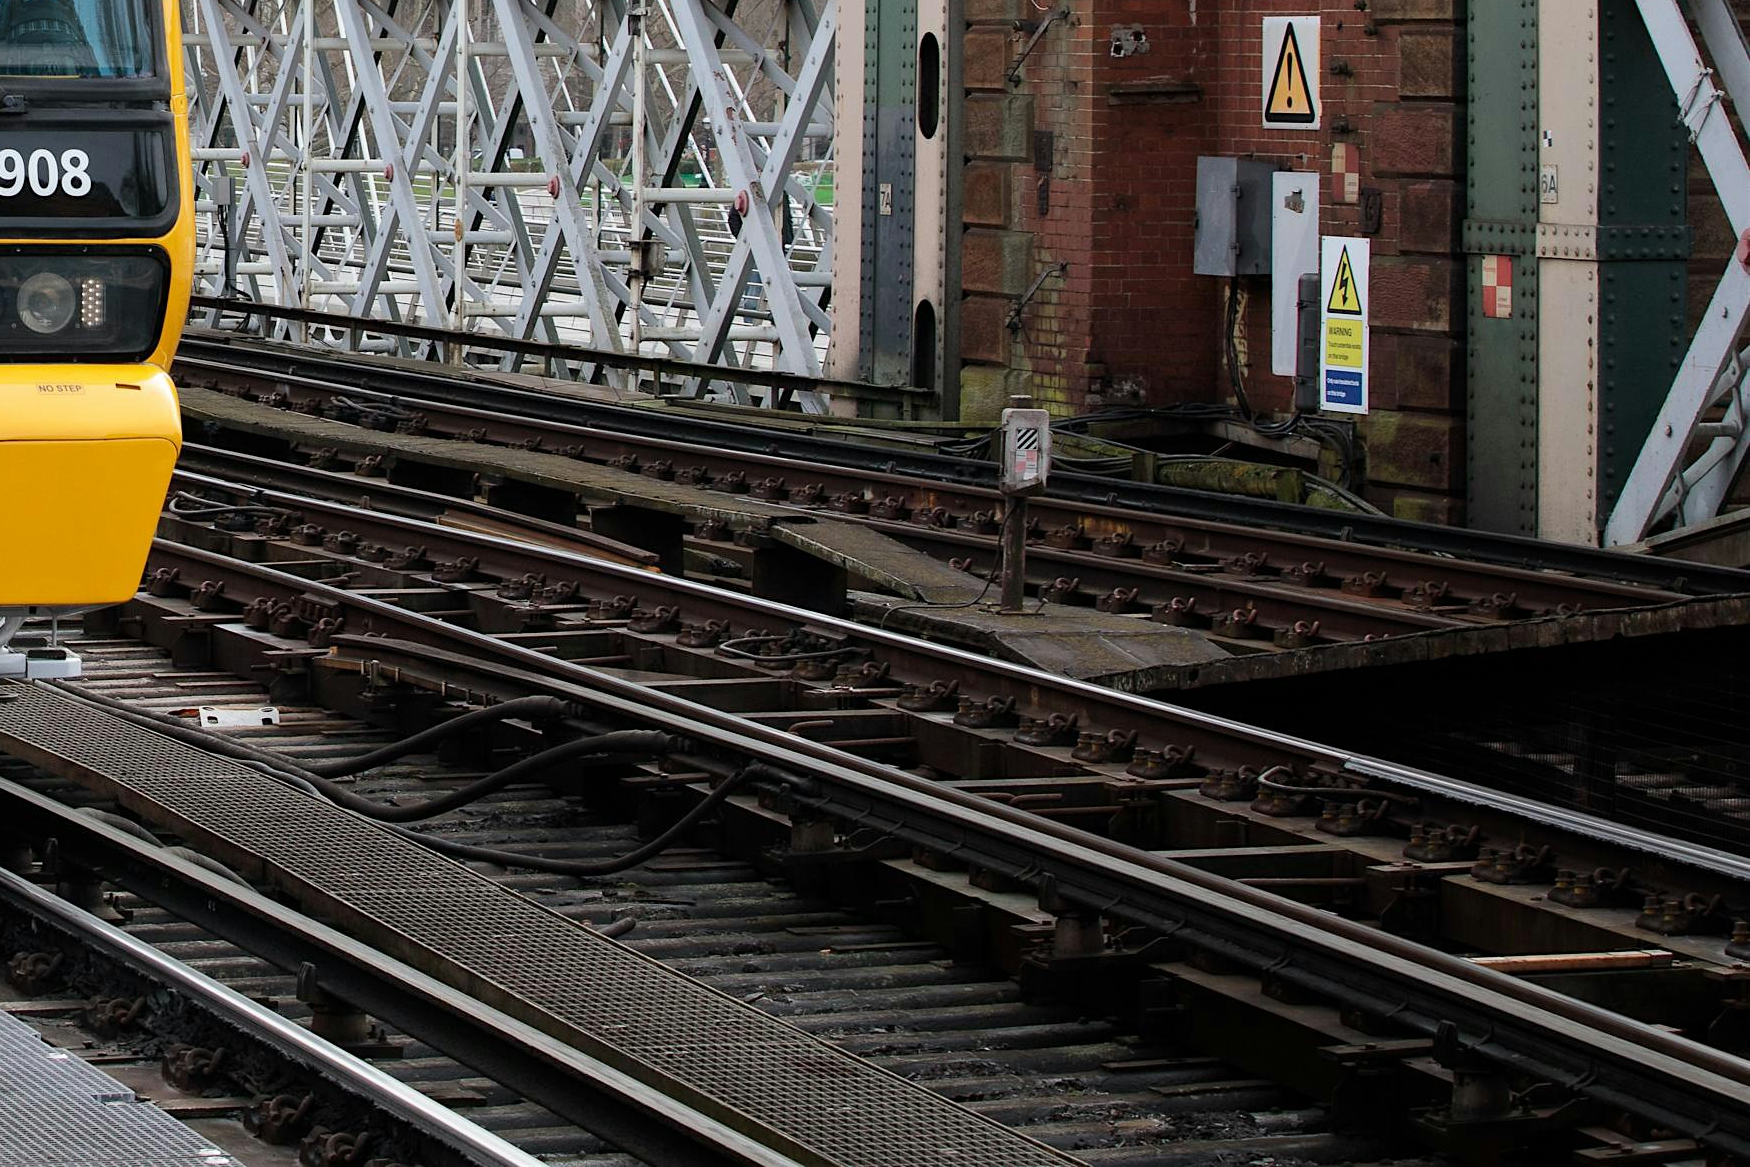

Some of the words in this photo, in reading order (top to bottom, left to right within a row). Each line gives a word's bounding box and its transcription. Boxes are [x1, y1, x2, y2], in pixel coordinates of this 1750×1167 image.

[1541, 173, 1558, 193] 6A
[880, 190, 893, 209] 7A
[1328, 326, 1352, 337] WARNING
[38, 384, 54, 393] NO
[56, 384, 82, 393] STEP
